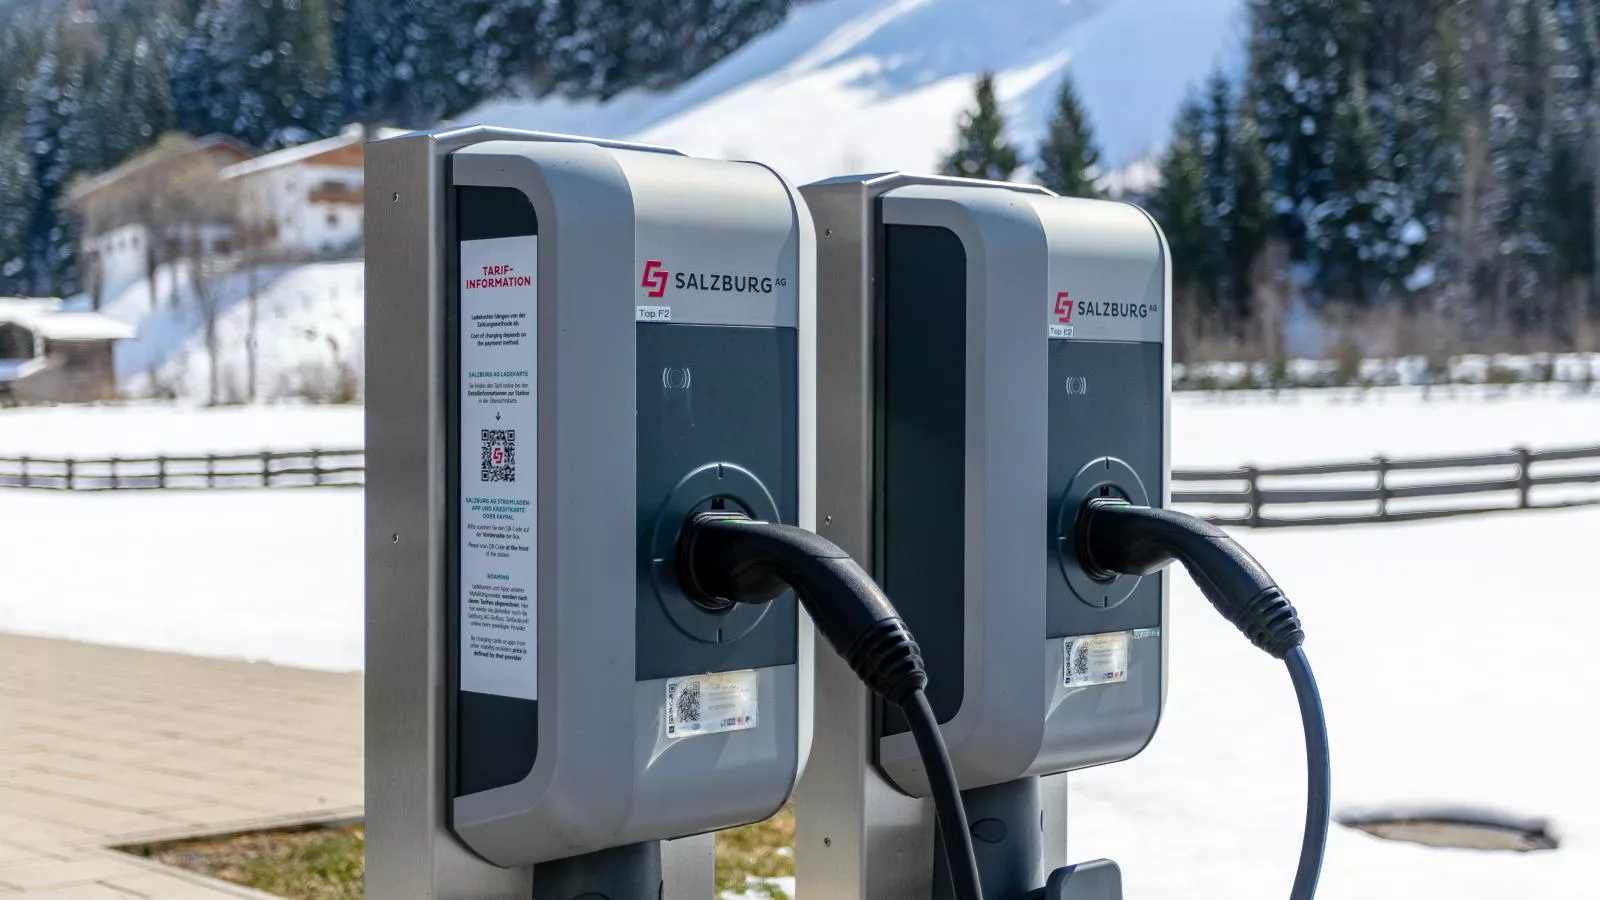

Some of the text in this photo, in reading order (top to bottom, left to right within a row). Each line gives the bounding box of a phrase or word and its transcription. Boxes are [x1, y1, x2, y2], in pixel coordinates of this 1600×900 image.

[483, 265, 513, 275] TARIF-
[466, 276, 531, 289] INFORMATION
[675, 272, 786, 293] SALZBURG AG
[639, 309, 656, 318] Top
[1078, 301, 1147, 318] SALZBURG
[1050, 328, 1061, 336] Top
